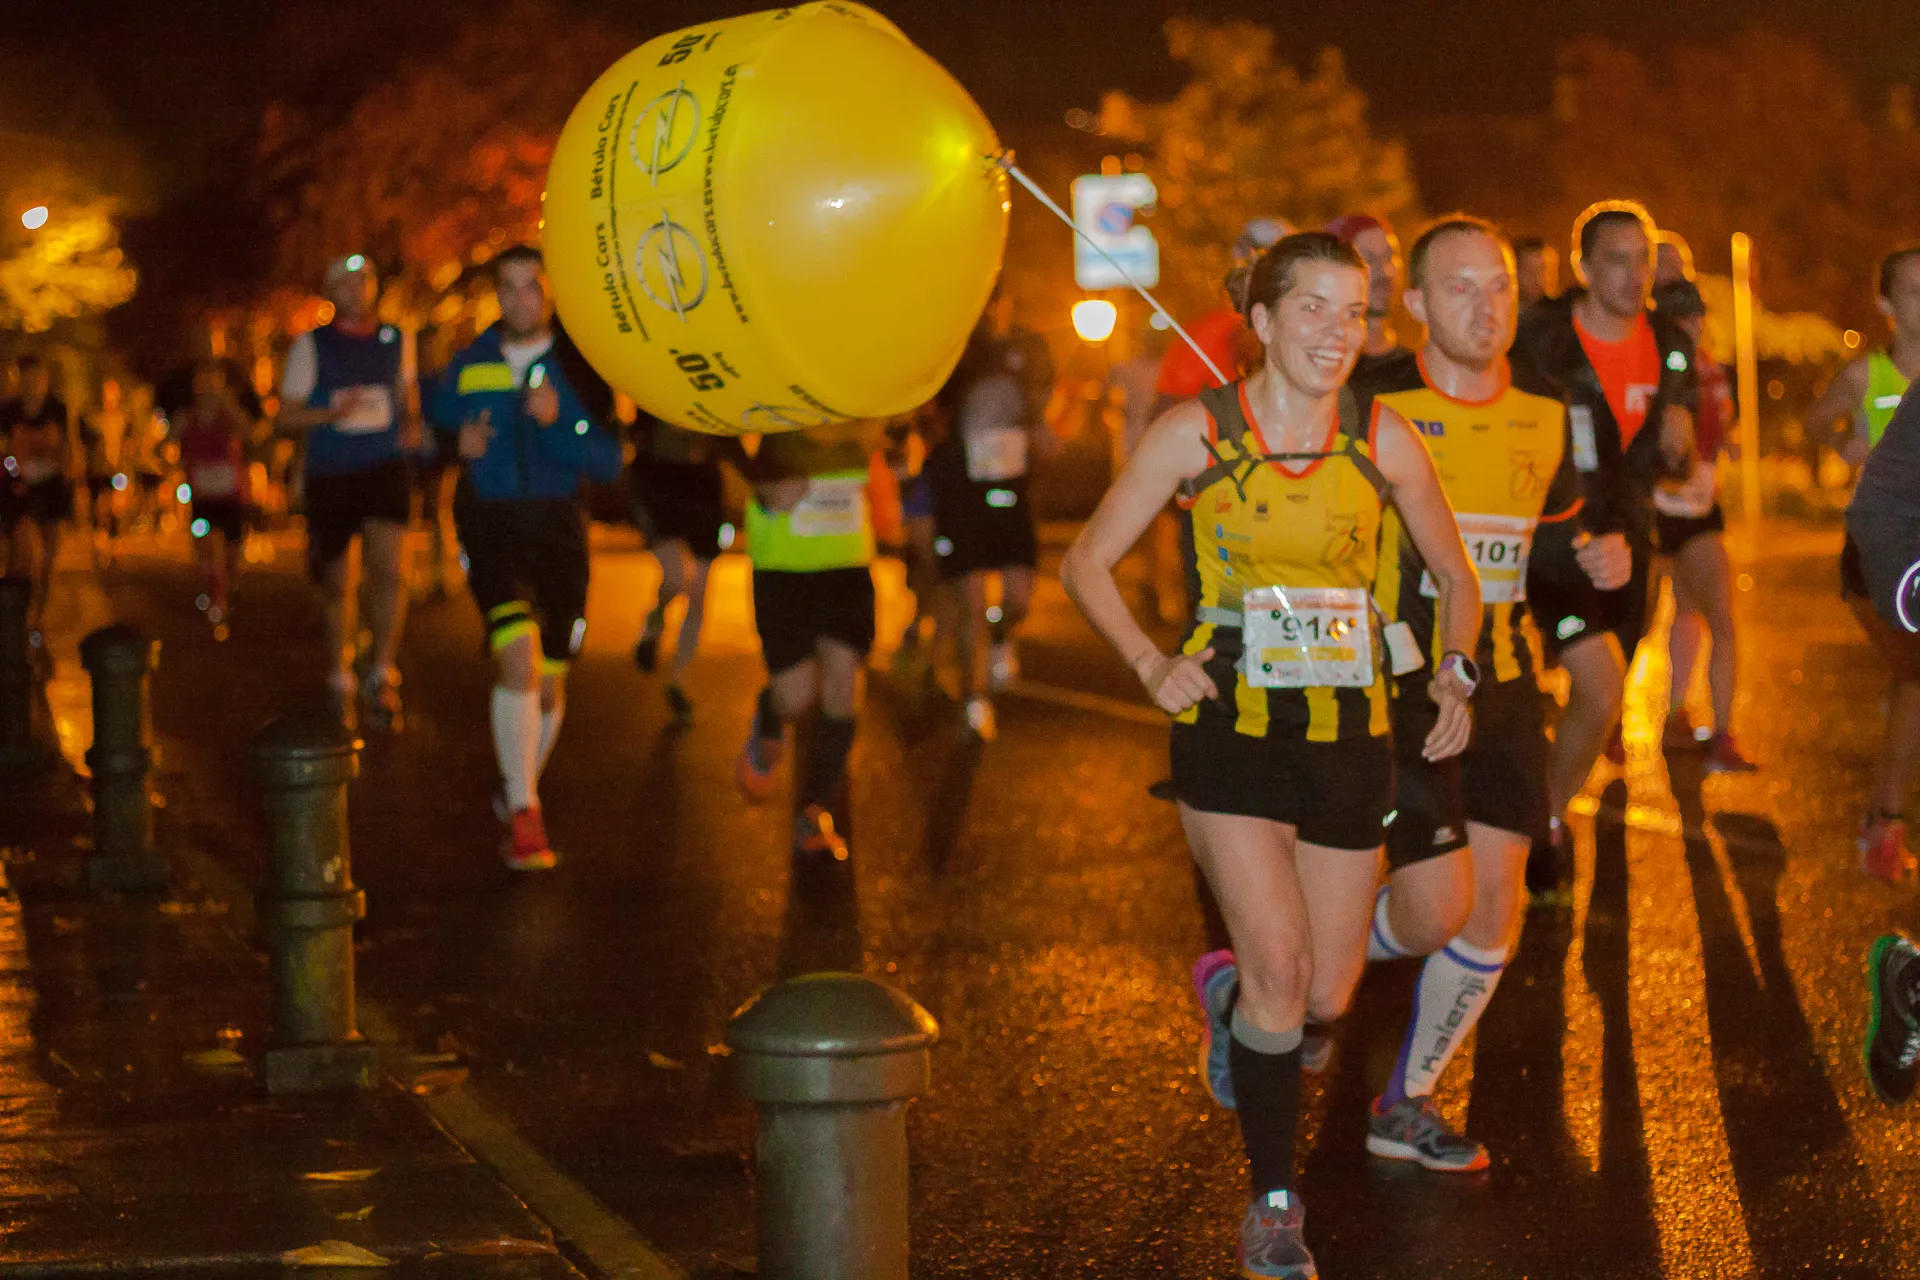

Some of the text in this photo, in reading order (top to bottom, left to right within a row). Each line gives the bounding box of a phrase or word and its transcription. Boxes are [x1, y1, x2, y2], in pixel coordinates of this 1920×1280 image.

[590, 136, 609, 200] Bétula
[595, 221, 610, 268] Cars
[602, 272, 633, 333] Bétula
[1473, 539, 1522, 564] 101
